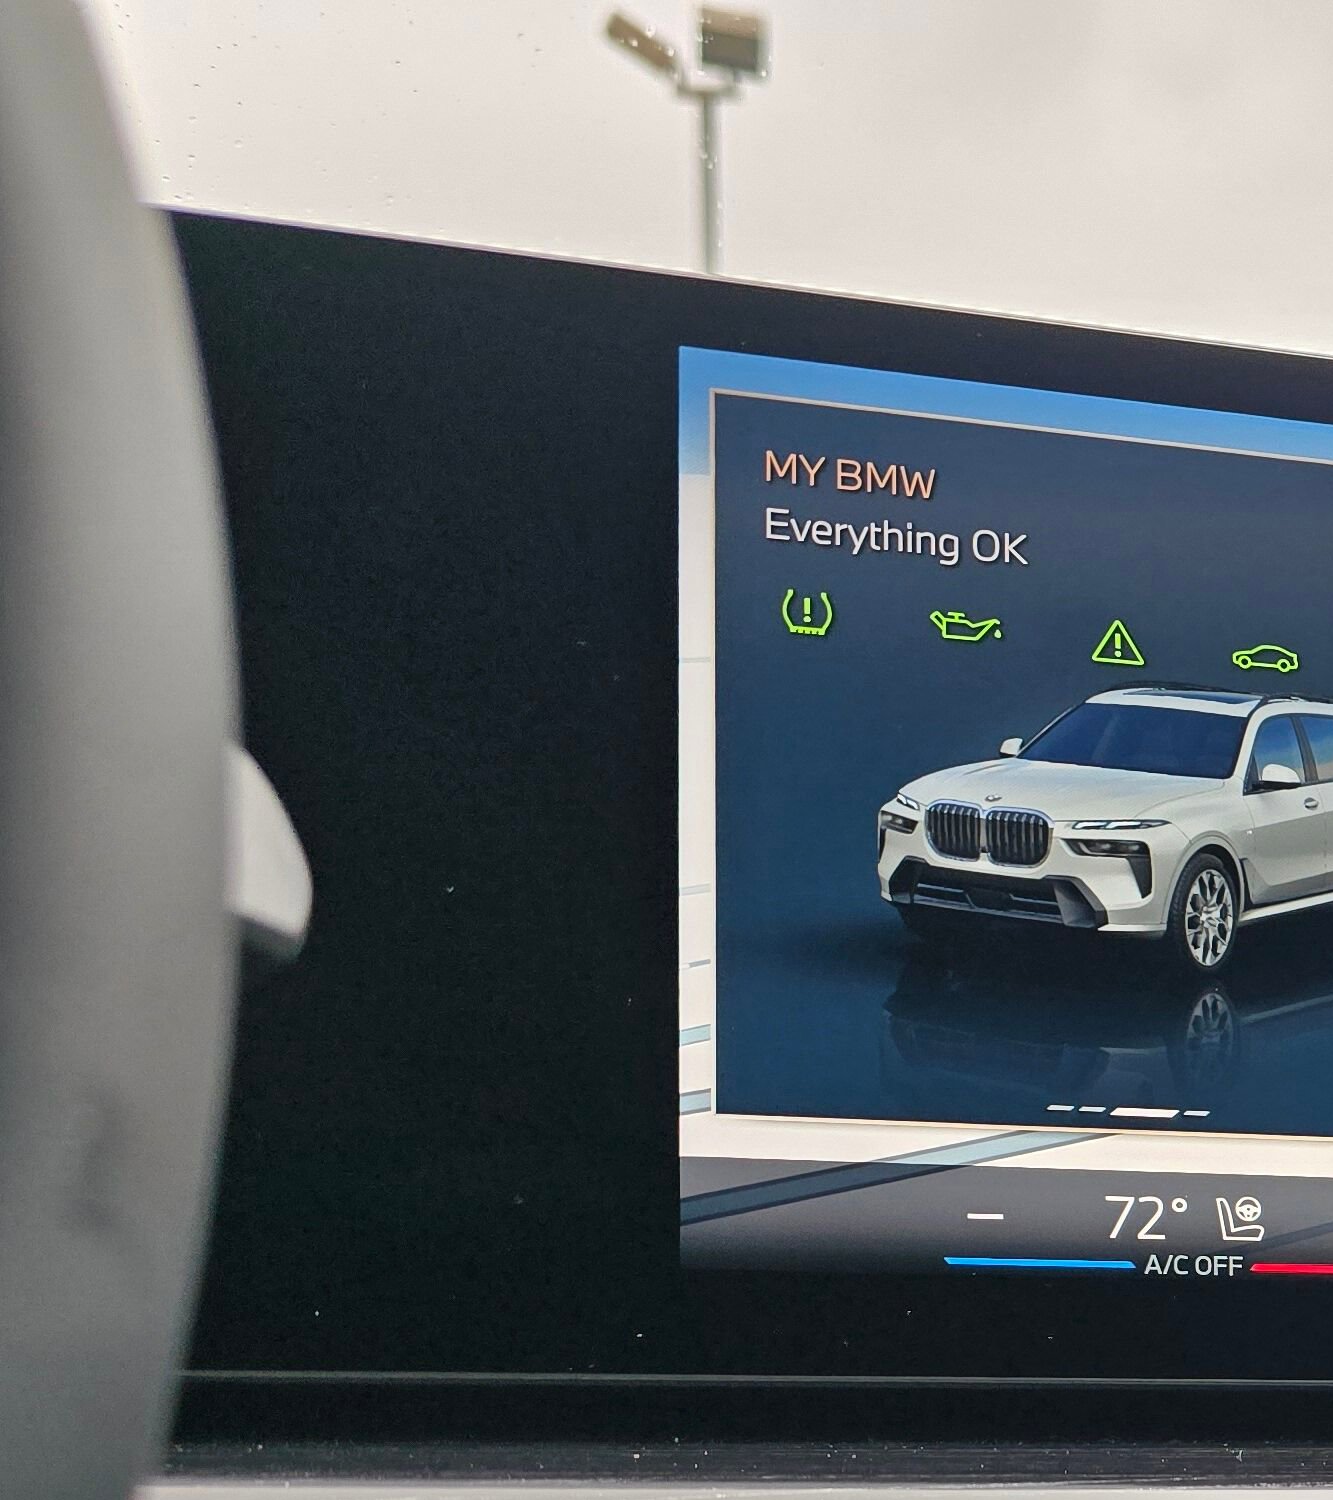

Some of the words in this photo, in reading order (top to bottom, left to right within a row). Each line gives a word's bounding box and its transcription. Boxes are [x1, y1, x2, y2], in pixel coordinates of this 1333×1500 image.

[765, 450, 826, 487] MY
[835, 458, 936, 499] BMW
[765, 507, 959, 566] Everything
[972, 529, 1029, 565] OK
[1144, 1254, 1189, 1275] A/C
[1195, 1255, 1244, 1277] OFF
